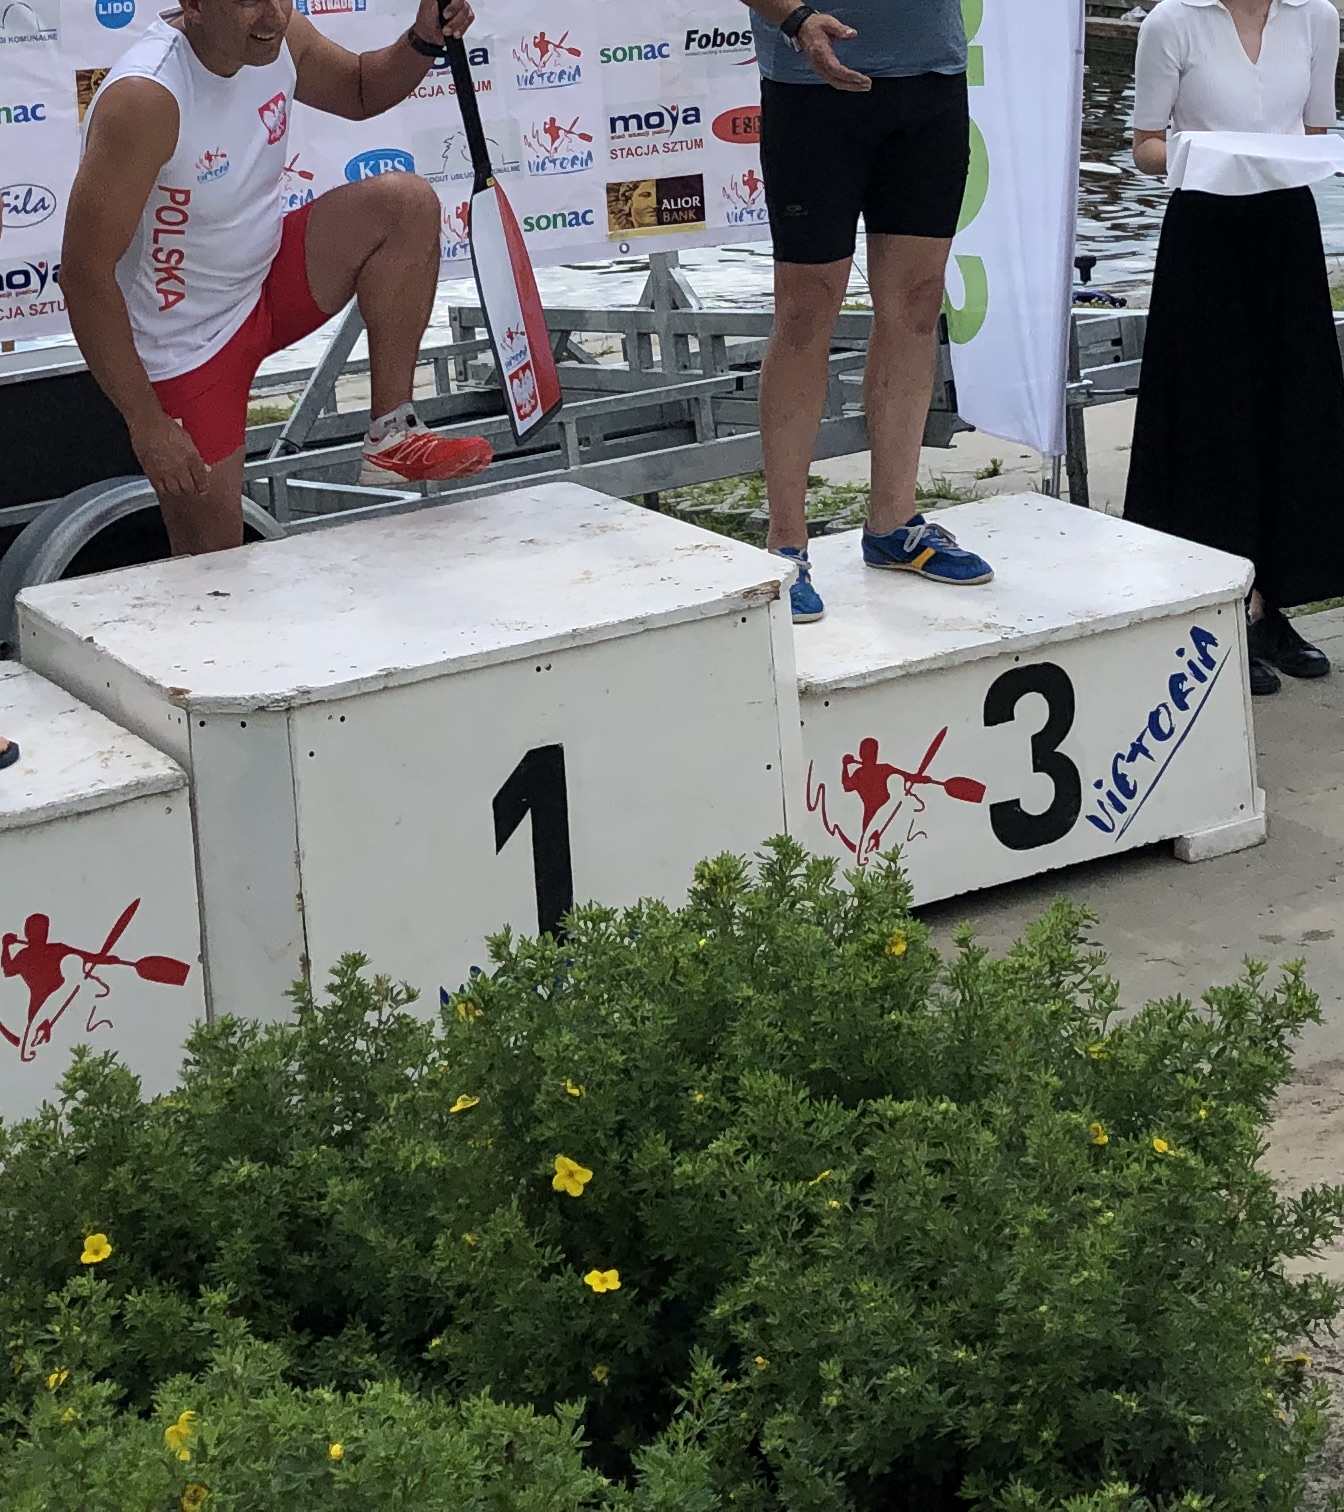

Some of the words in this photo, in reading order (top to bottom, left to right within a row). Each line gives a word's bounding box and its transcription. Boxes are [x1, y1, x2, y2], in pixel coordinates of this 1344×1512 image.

[98, 1, 133, 15] LIDO
[685, 28, 753, 50] Fobos
[600, 42, 670, 63] sonac
[610, 104, 701, 137] moya
[610, 143, 659, 160] STACJA
[662, 138, 703, 155] SZTUM
[661, 196, 701, 210] ALIOR
[523, 209, 594, 232] sonac
[663, 209, 696, 223] BANK
[152, 184, 190, 312] POLSKA
[29, 298, 67, 318] SZTU
[982, 661, 1083, 851] 3
[492, 742, 574, 946] 1
